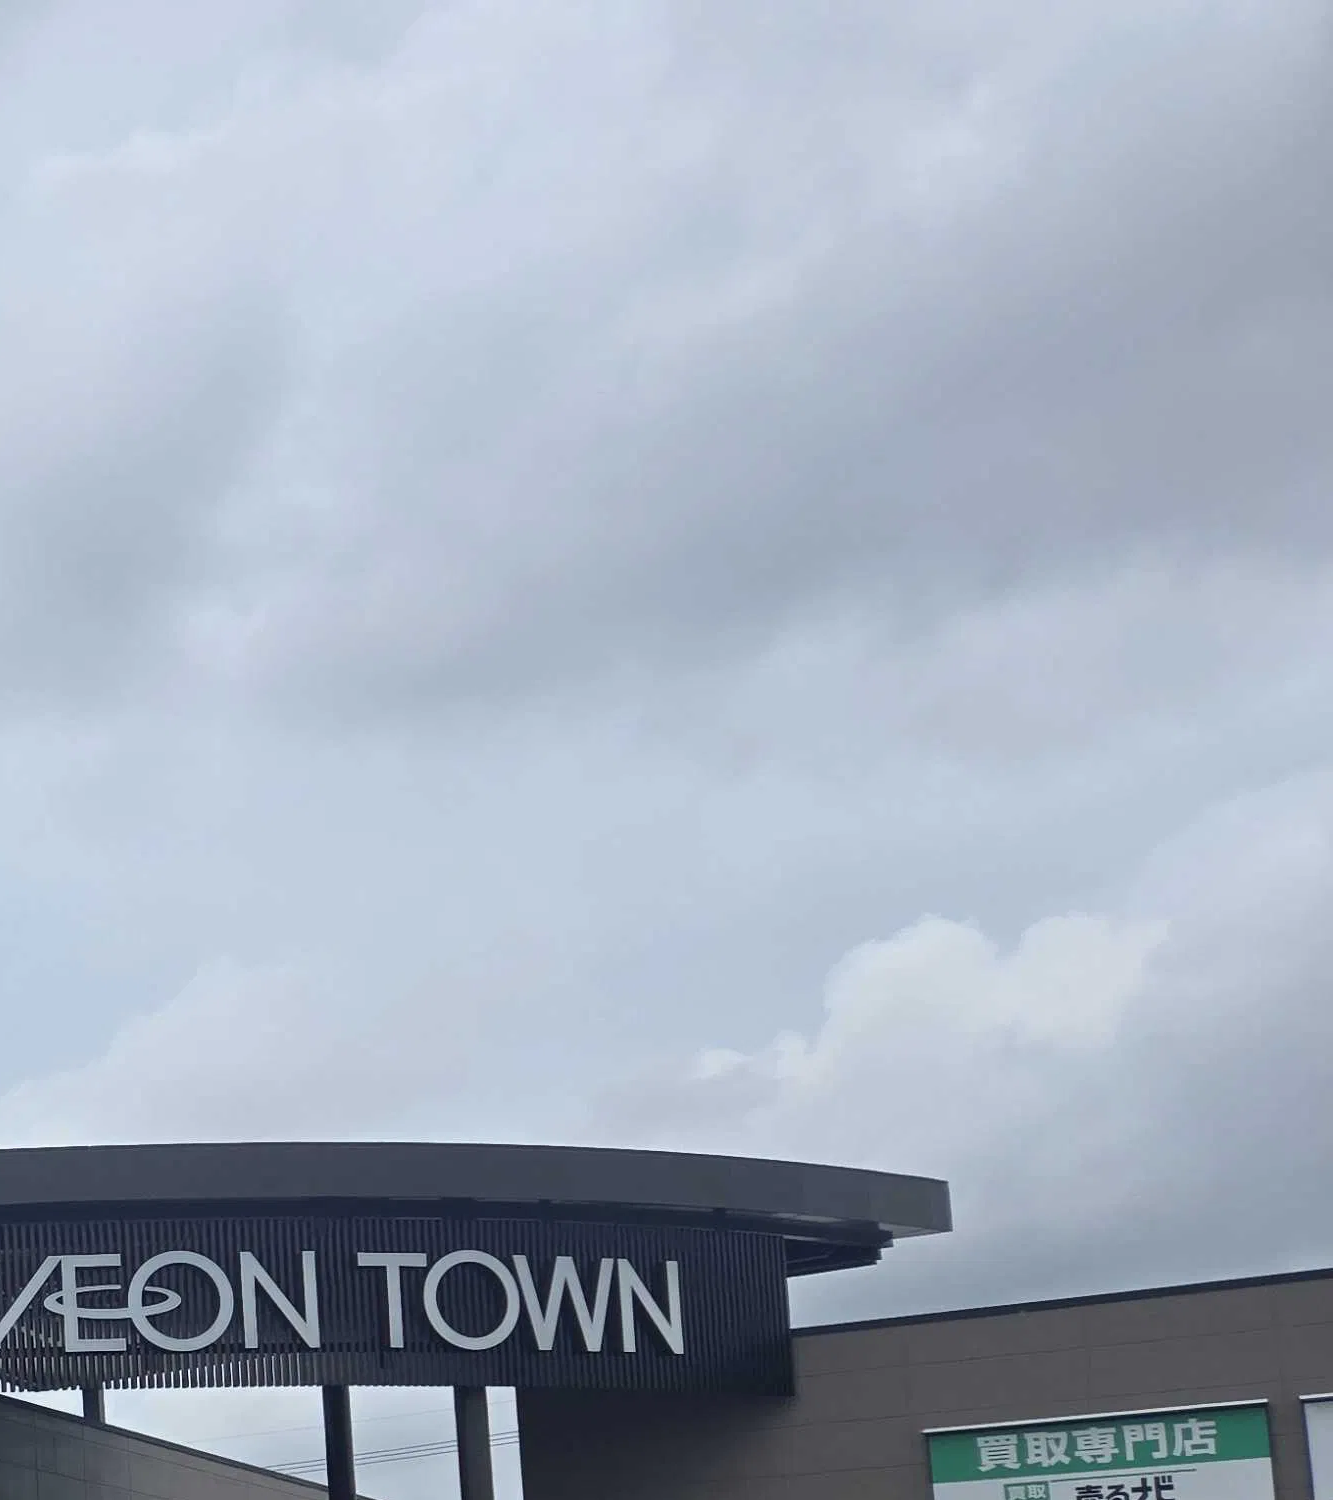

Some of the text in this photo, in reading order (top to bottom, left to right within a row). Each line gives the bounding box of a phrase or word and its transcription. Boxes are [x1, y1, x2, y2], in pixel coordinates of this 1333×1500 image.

[356, 1249, 684, 1356] TOWN
[976, 1417, 1218, 1473] 買取専門店
